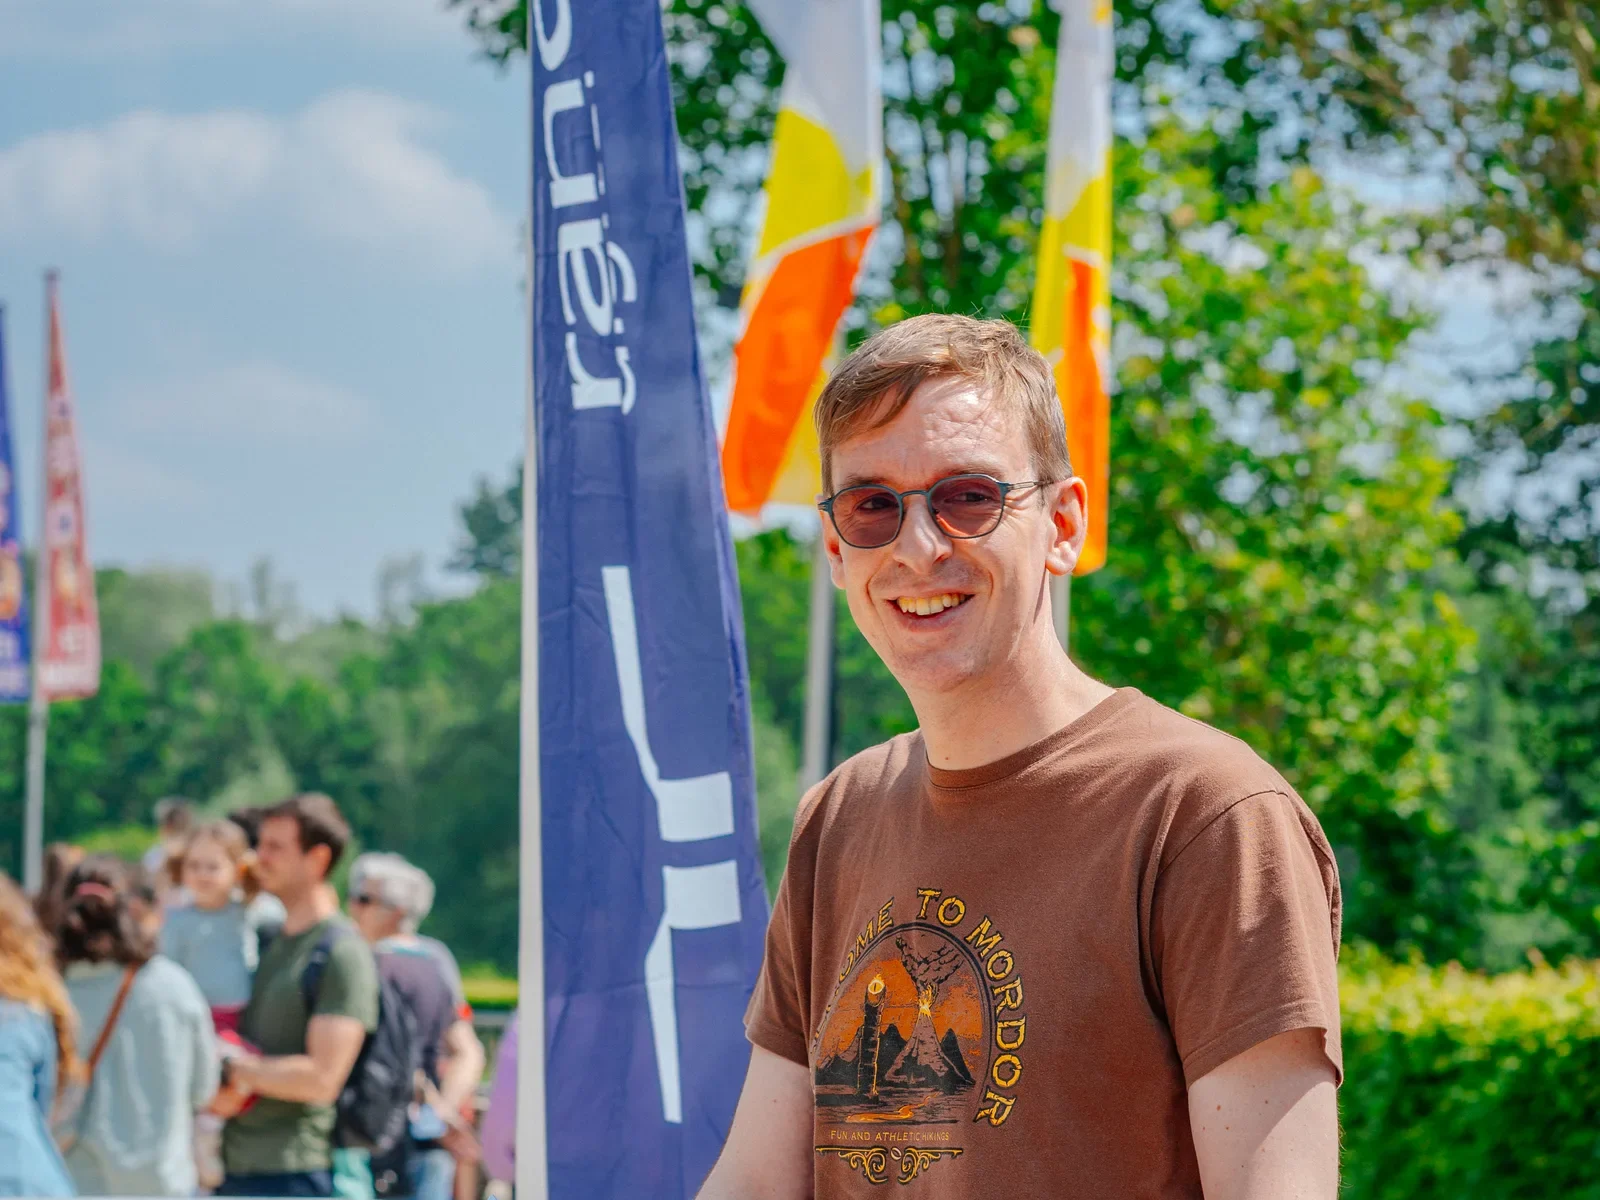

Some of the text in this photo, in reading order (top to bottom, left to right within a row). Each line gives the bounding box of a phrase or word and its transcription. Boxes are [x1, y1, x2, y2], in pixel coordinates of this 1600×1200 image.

[916, 887, 967, 926] TO
[964, 915, 1027, 1128] MORDOR
[831, 1130, 848, 1140] FUN
[850, 1131, 871, 1141] AND
[875, 1131, 920, 1142] ATHLETIC
